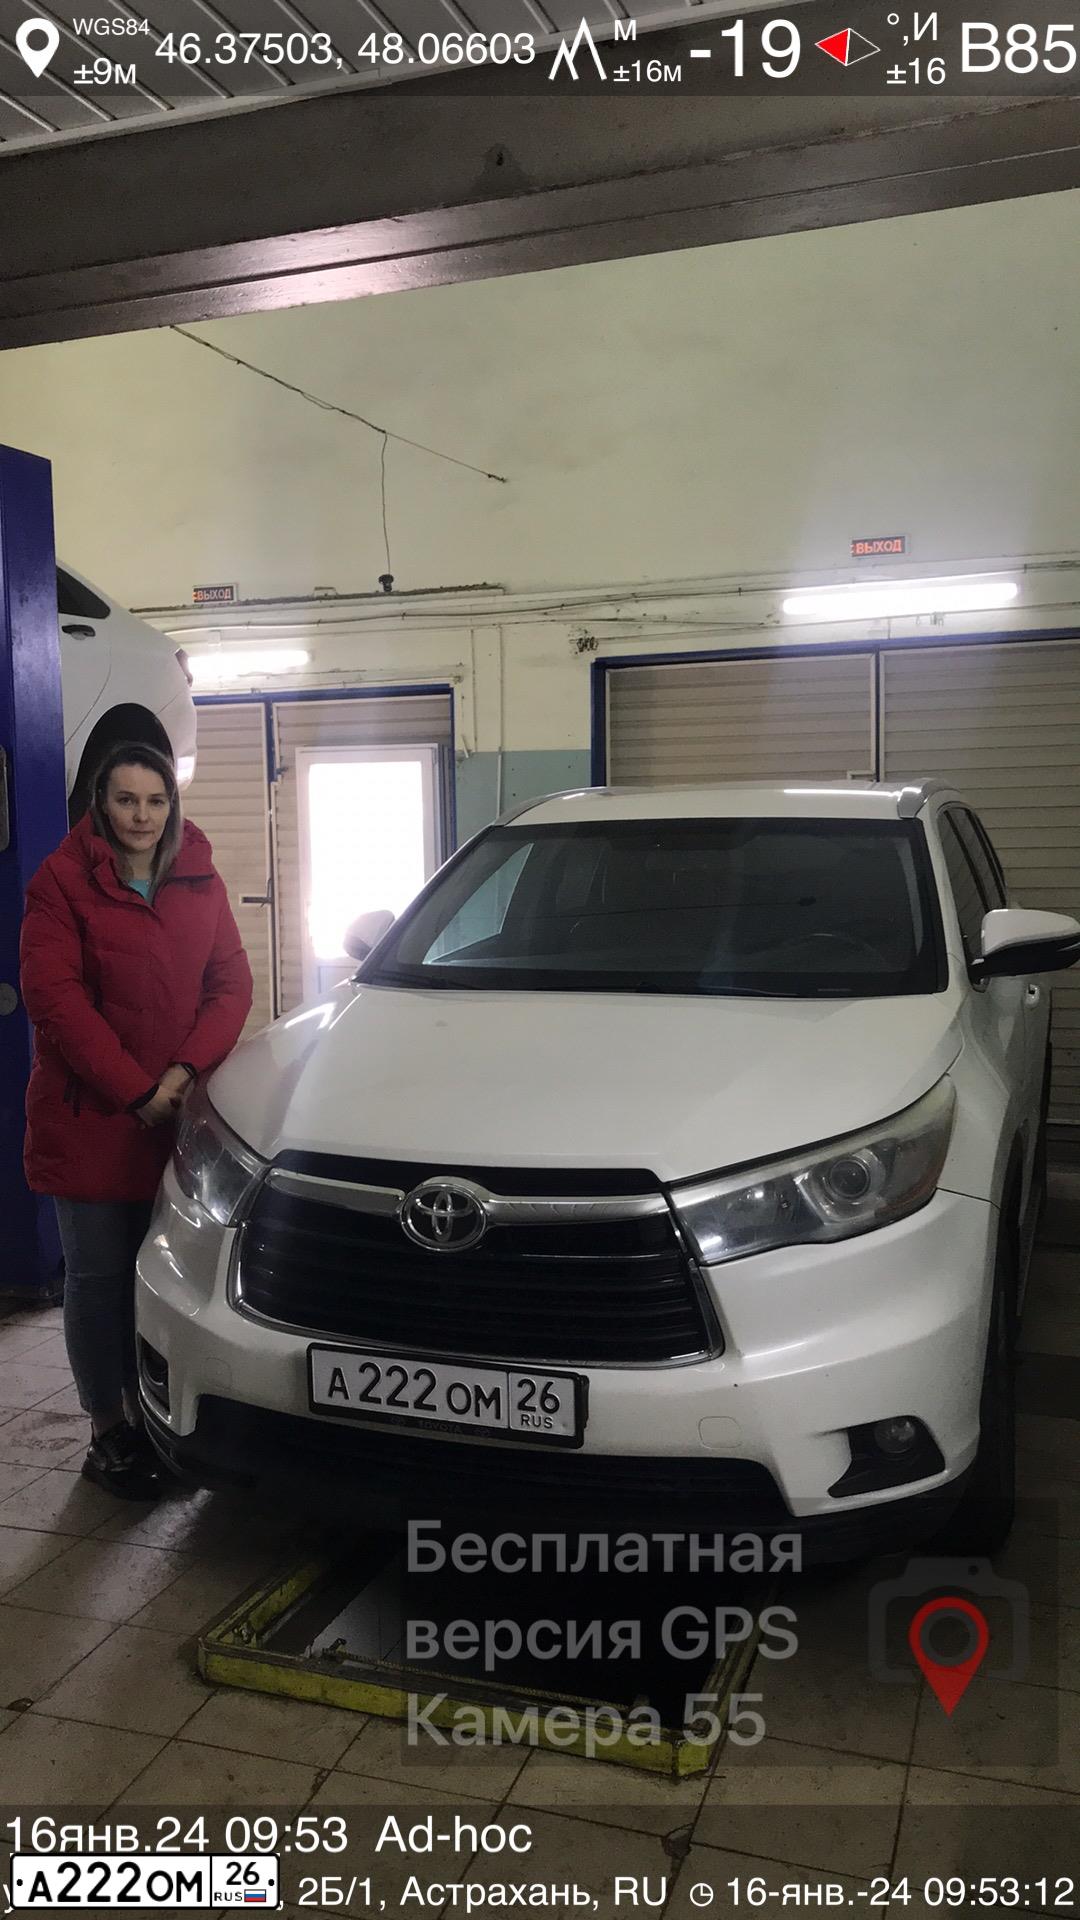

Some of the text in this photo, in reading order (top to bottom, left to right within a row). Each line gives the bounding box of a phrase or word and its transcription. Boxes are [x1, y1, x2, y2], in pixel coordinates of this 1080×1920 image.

[855, 539, 902, 554] ВЫХОД
[197, 588, 231, 600] ВЫХОД
[517, 1378, 560, 1414] 26
[520, 1413, 554, 1429] RUS
